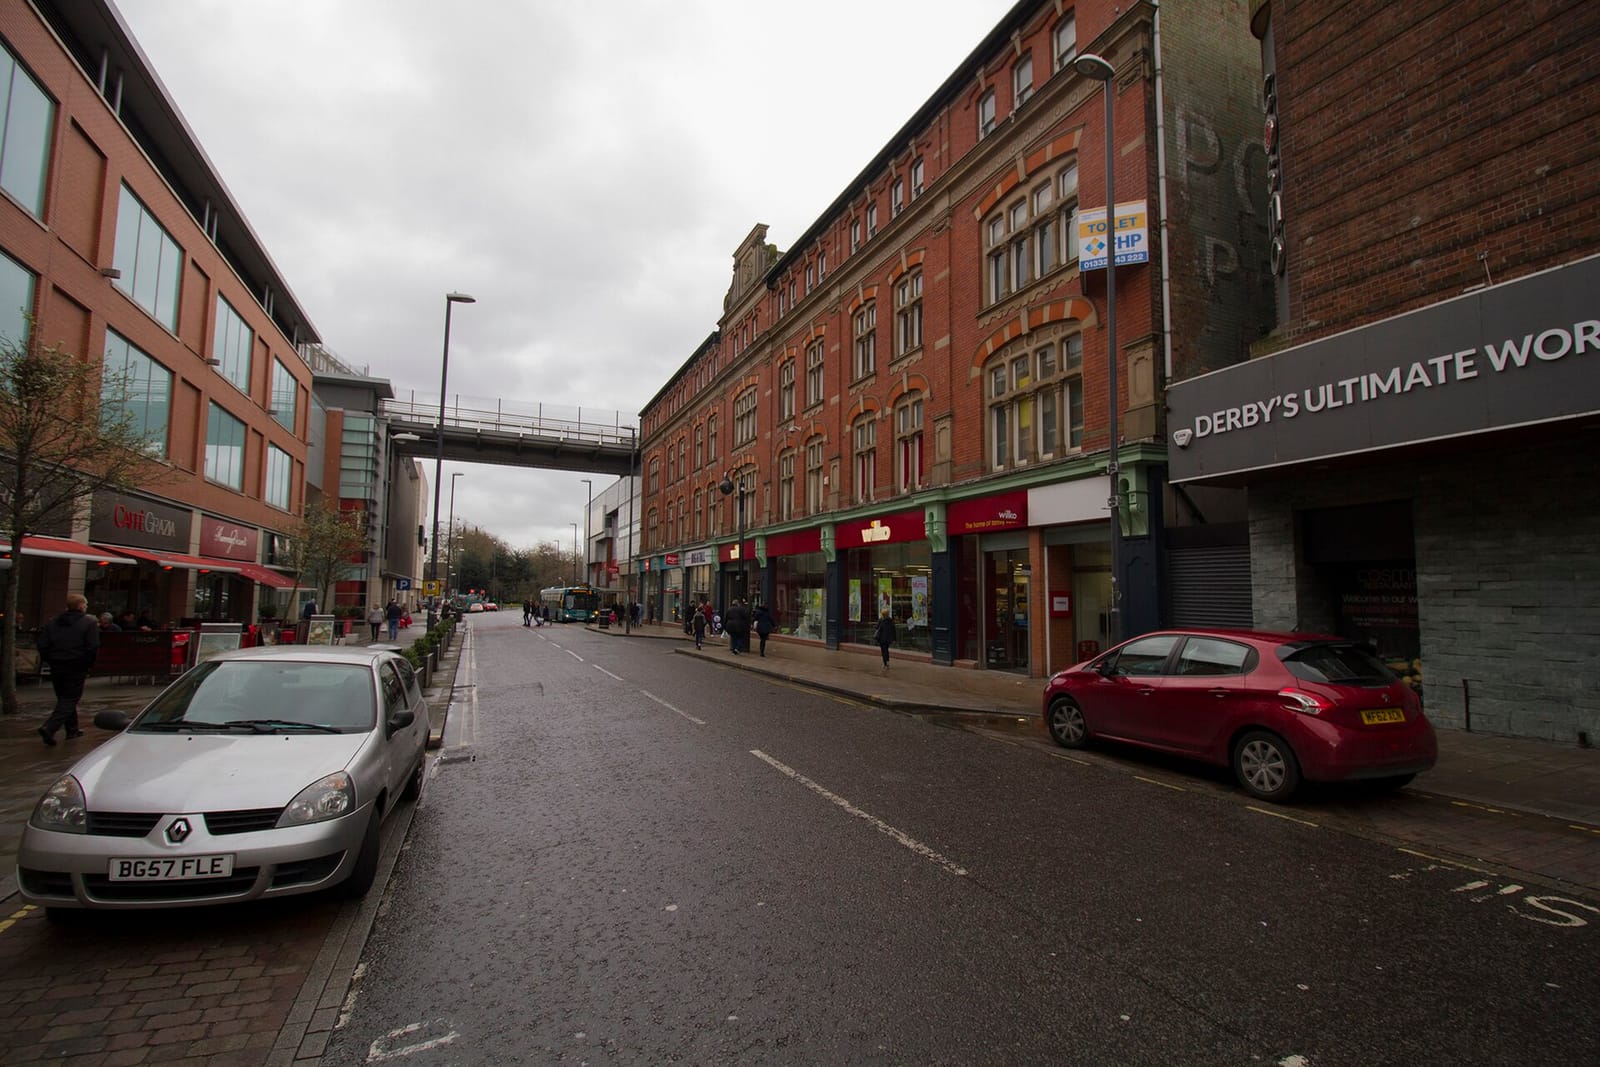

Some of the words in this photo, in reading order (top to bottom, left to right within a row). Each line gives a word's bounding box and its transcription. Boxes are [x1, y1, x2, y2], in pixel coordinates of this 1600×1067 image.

[1088, 222, 1107, 234] TO
[1114, 233, 1142, 249] HP
[1127, 252, 1144, 262] 222
[1195, 393, 1299, 438] DERBY'S
[1304, 347, 1479, 413] ULTIMATE
[998, 509, 1017, 520] wilko
[400, 580, 408, 589] P
[119, 860, 176, 877] BG57
[181, 857, 224, 876] FLE
